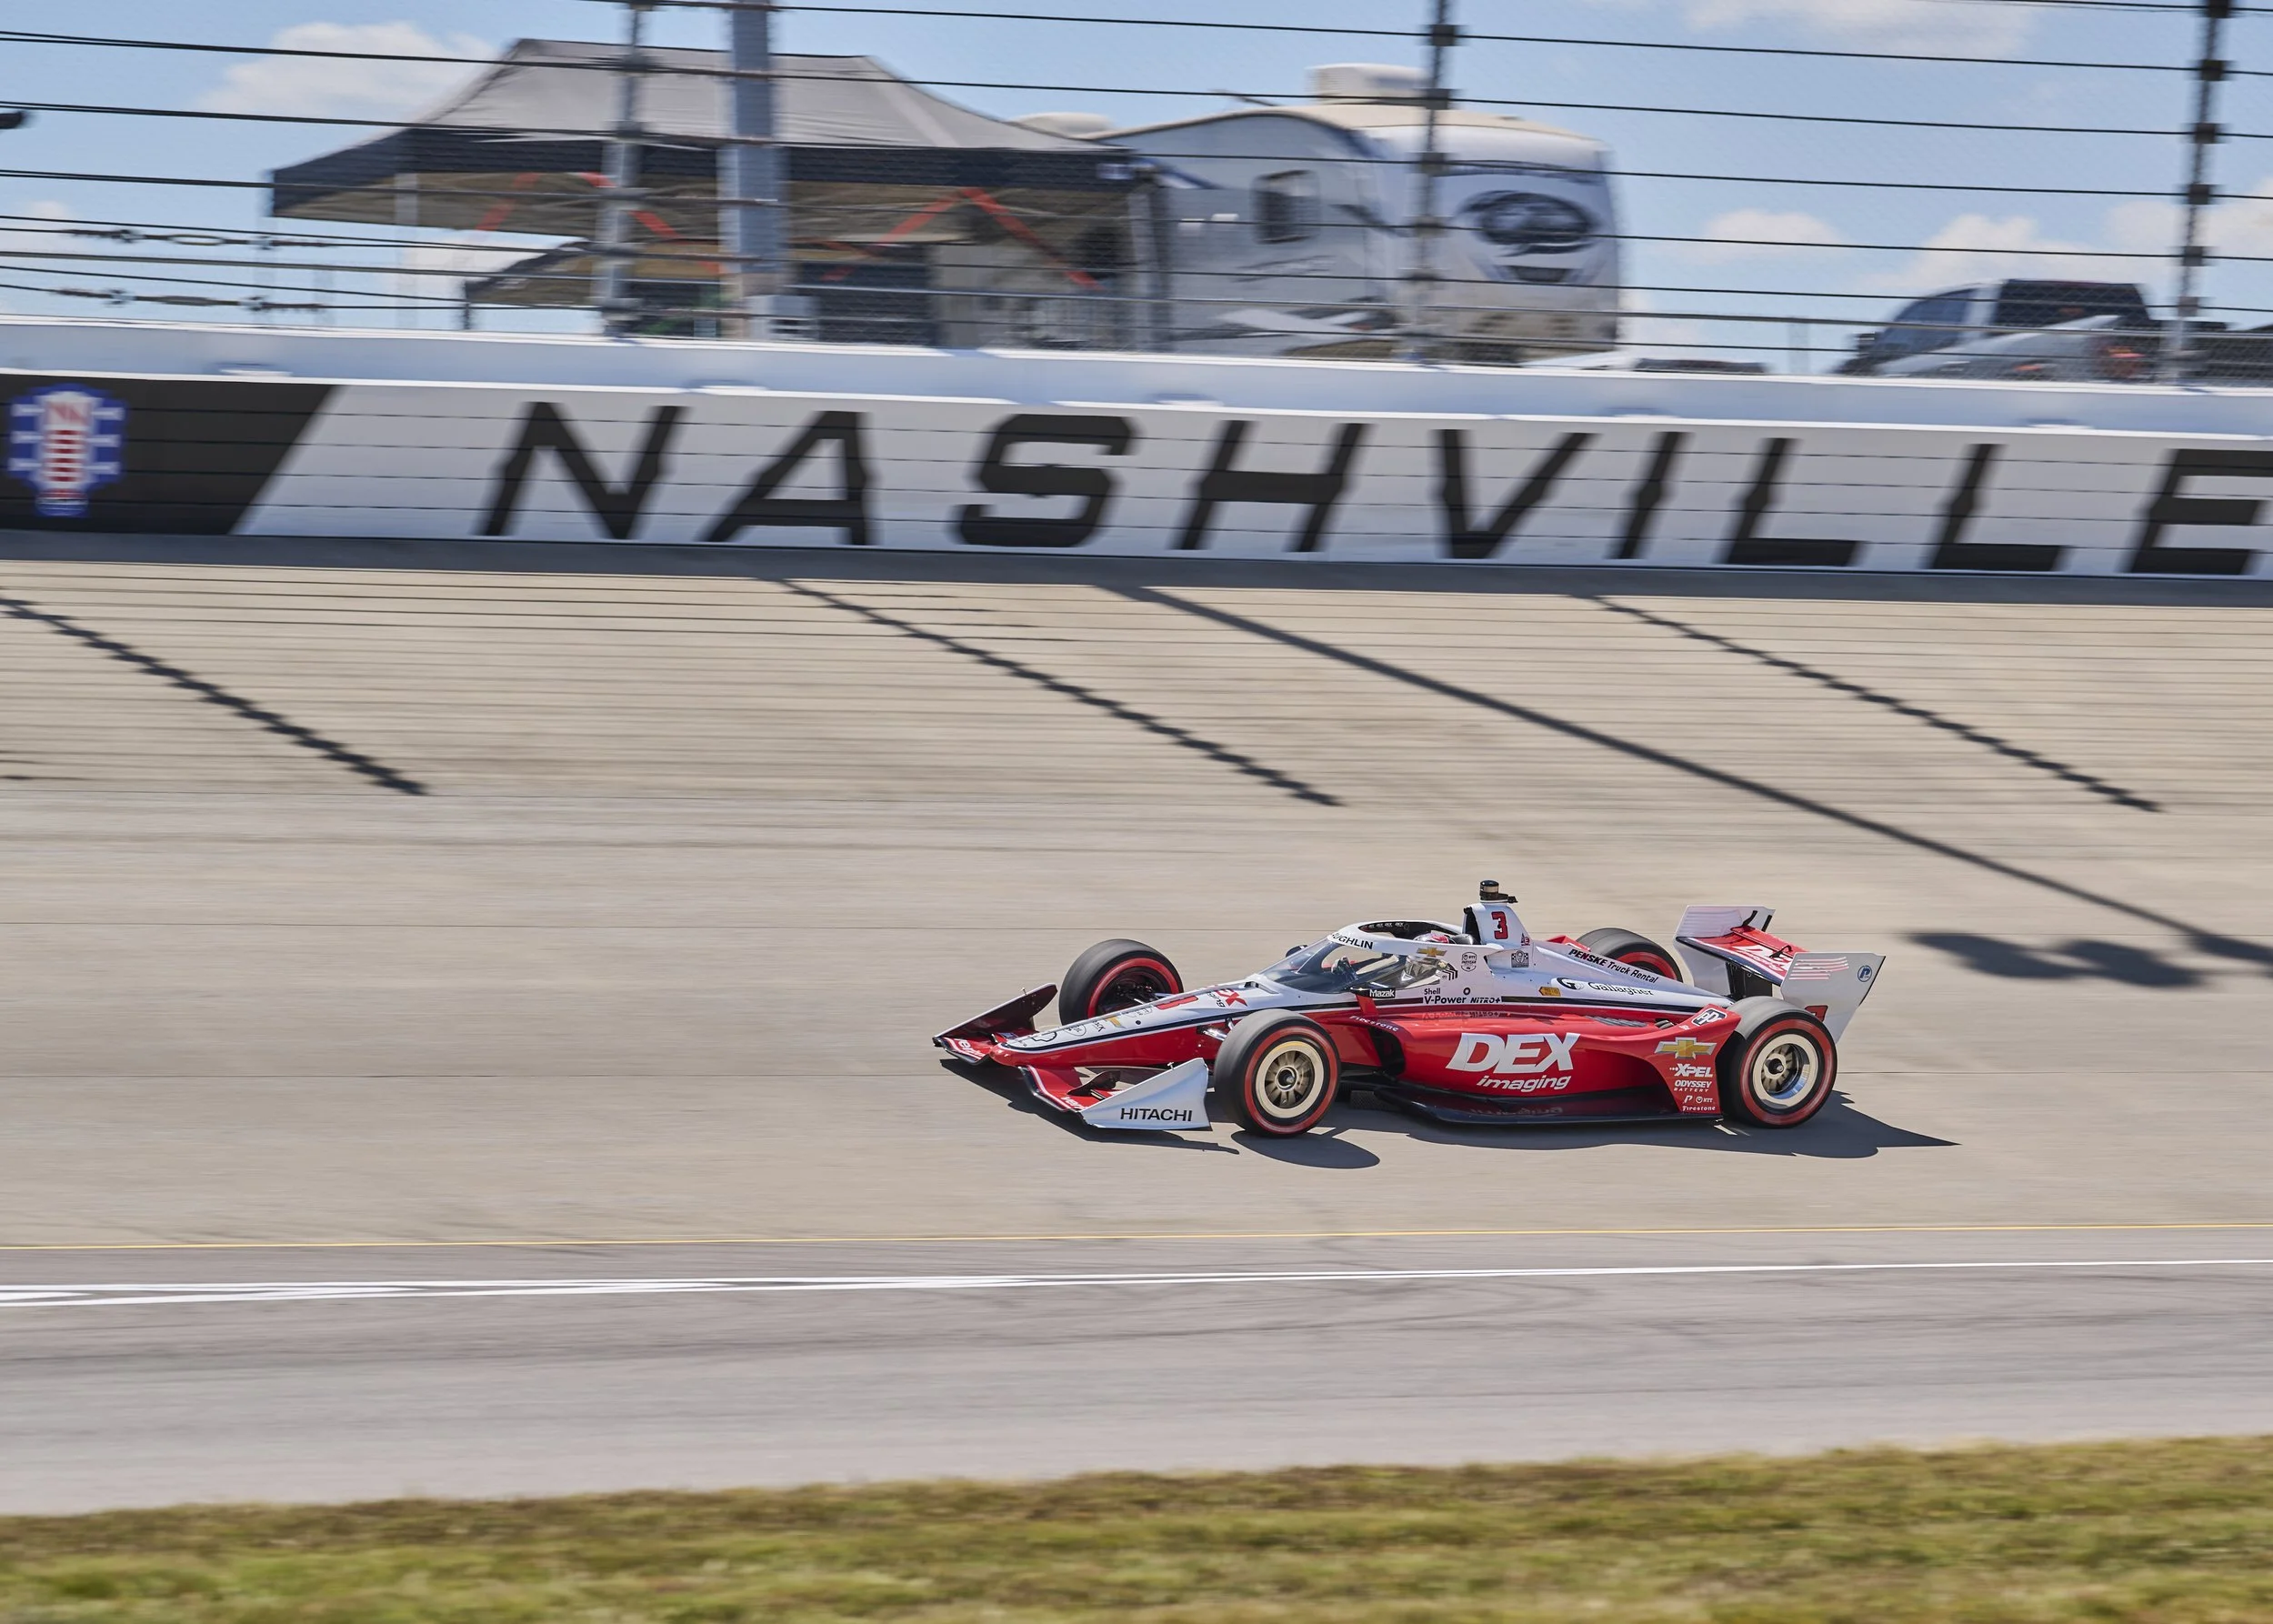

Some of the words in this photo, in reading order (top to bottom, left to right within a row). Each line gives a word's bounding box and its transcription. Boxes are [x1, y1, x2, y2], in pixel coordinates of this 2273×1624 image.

[475, 400, 2273, 576] NASHVILLE
[1491, 911, 1508, 939] 3
[1332, 931, 1373, 950] UGHLIN
[1567, 948, 1607, 966] PENSKE
[1607, 961, 1631, 975] Truck
[1630, 969, 1659, 984] Rental
[1369, 989, 1395, 998] Mazak
[1424, 987, 1441, 996] Shell
[1587, 981, 1655, 996] Gallagher
[1424, 996, 1467, 1005] V-Power
[1349, 1015, 1399, 1032] Firestone
[1446, 1032, 1580, 1074] DEX
[1674, 1063, 1714, 1078] XPEL
[1477, 1075, 1571, 1093] imaging
[1674, 1079, 1713, 1088] ODYSSEY
[1120, 1108, 1193, 1122] HITACHI
